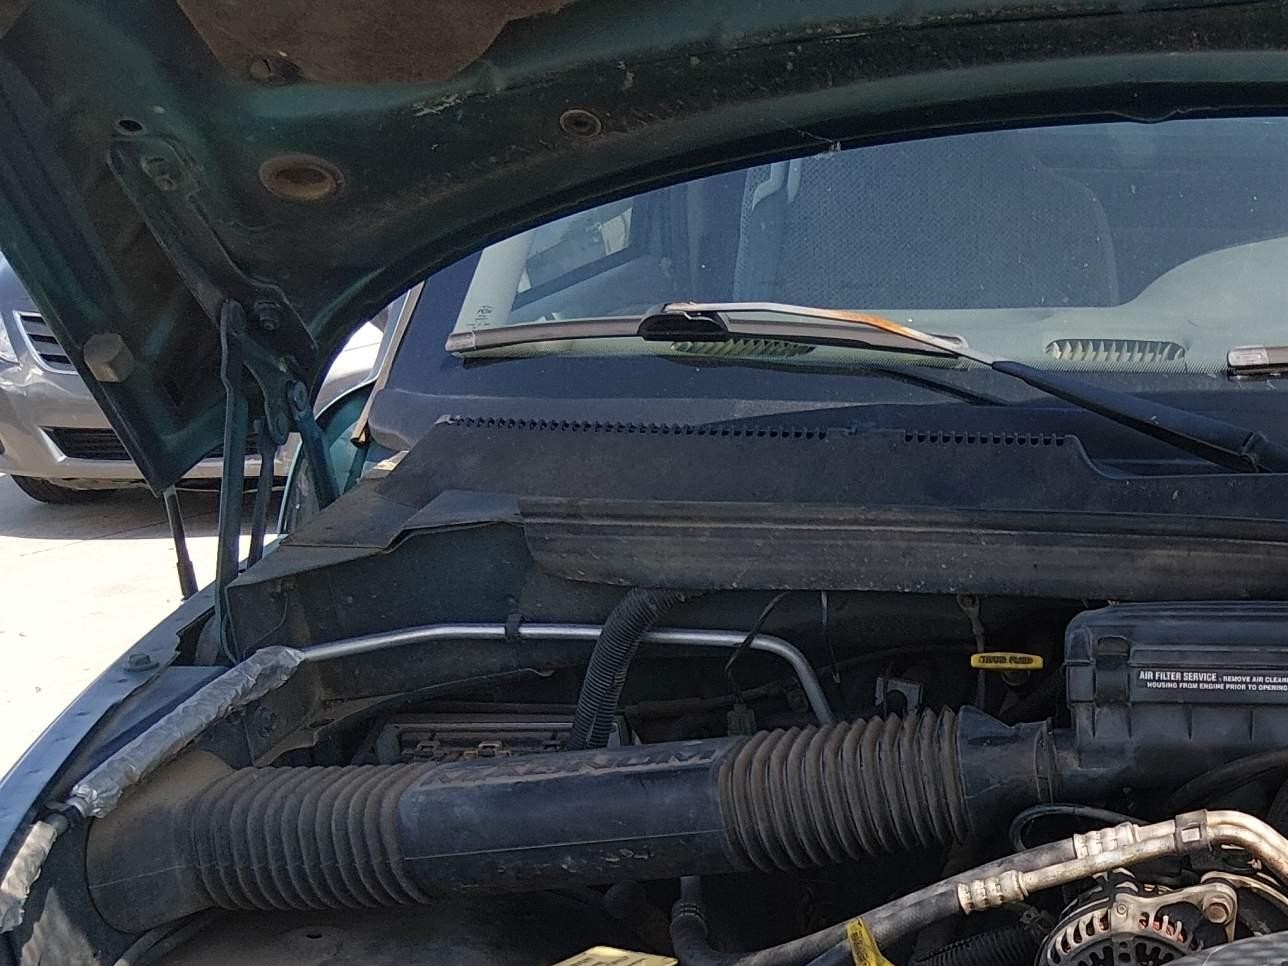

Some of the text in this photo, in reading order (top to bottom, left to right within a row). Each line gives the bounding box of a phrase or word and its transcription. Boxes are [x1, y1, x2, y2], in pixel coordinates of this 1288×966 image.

[1139, 671, 1154, 680] AIR
[1155, 671, 1182, 681] FILTER
[1183, 672, 1217, 682] SERVICE
